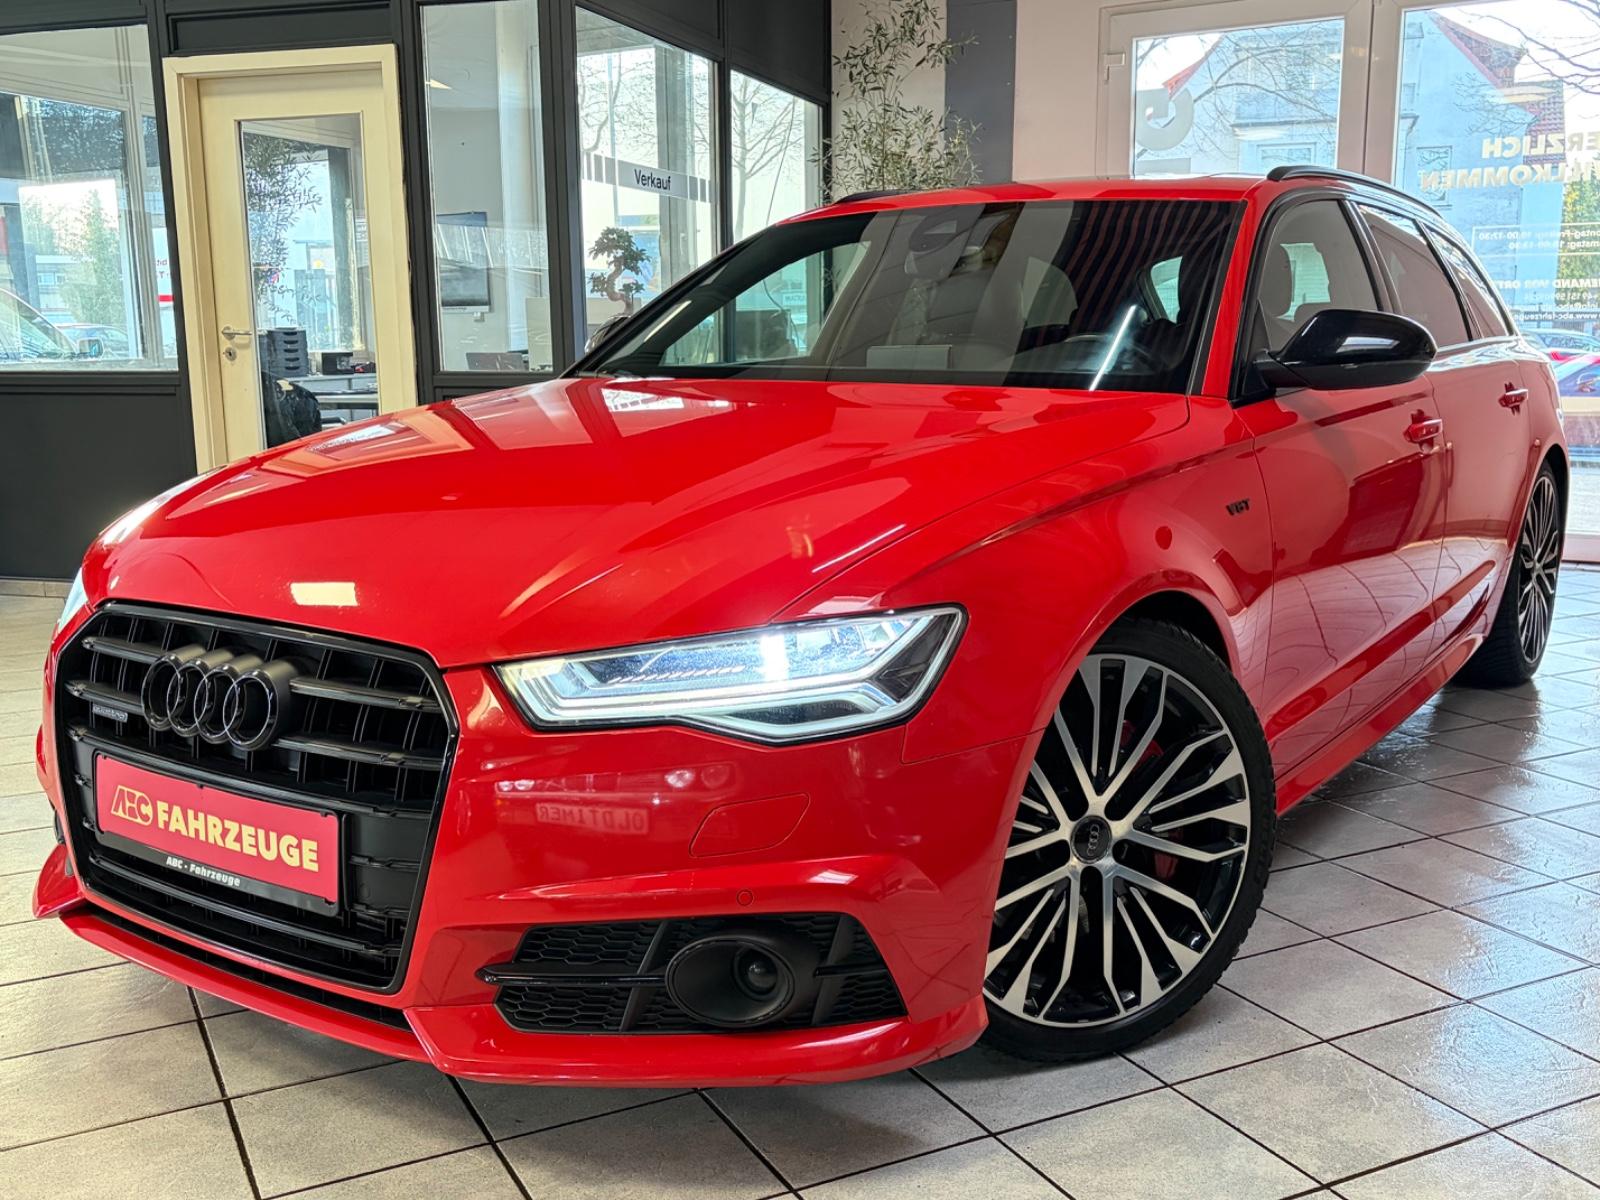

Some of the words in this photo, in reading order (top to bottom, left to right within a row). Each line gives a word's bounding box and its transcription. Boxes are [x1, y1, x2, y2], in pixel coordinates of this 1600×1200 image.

[634, 169, 671, 191] Verkauf
[1226, 499, 1250, 515] V6T
[157, 801, 319, 872] FAHRZEUGE
[166, 856, 183, 869] ABC
[190, 863, 241, 887] Fahrzeuge
